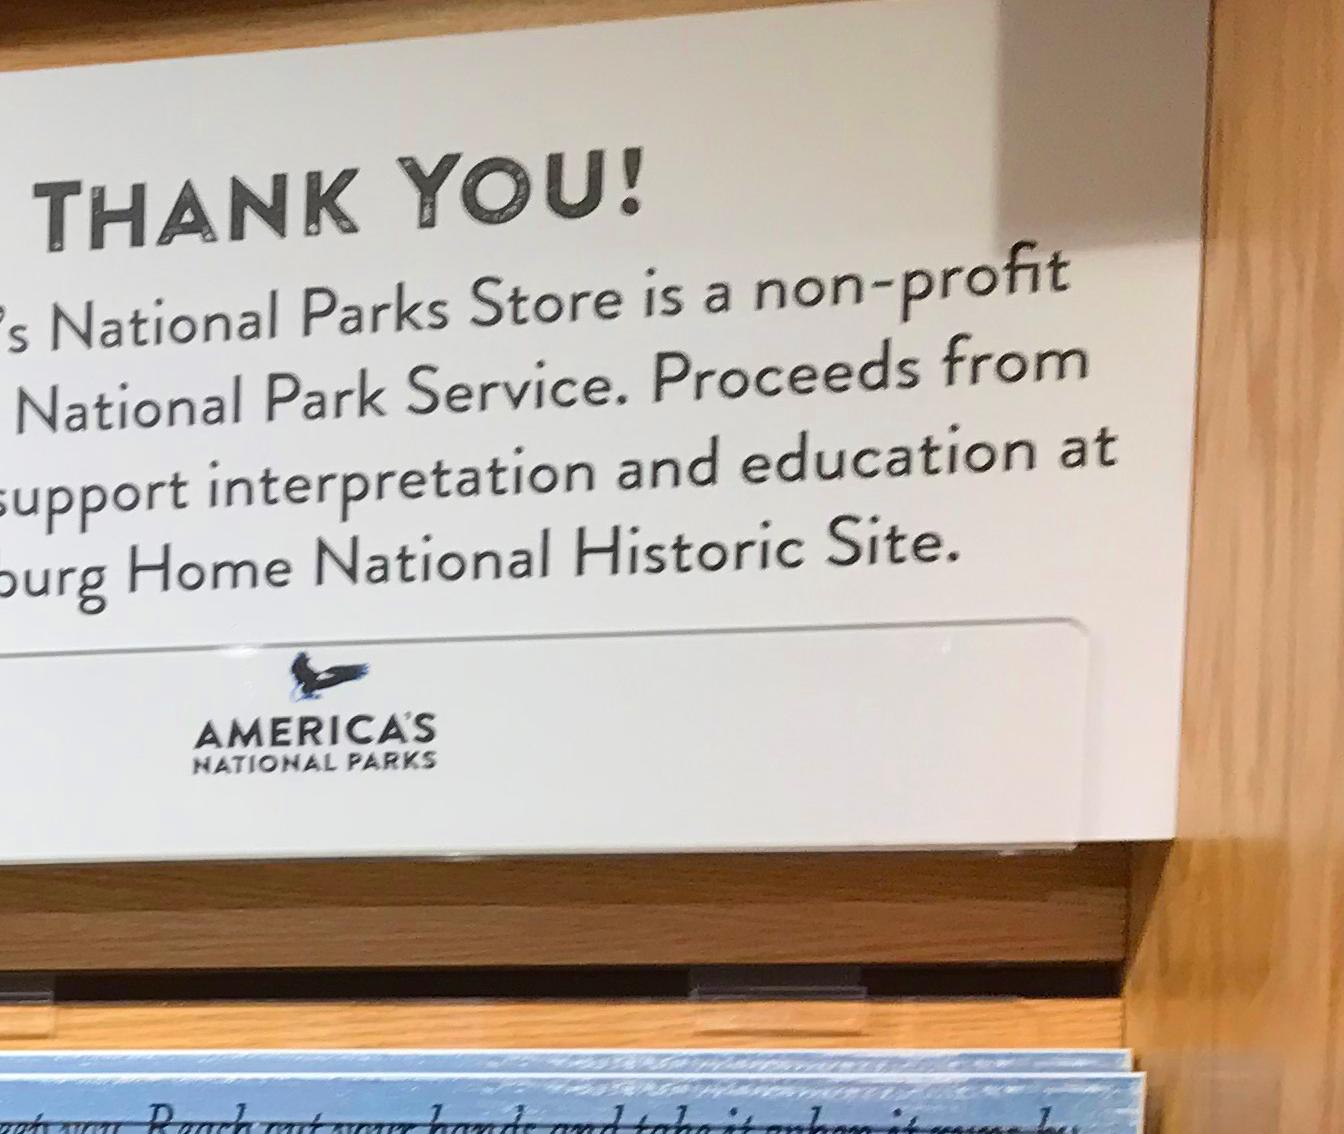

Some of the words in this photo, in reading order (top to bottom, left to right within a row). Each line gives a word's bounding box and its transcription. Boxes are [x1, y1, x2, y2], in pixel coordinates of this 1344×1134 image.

[34, 168, 358, 252] THANK
[397, 147, 642, 228] YOU!
[53, 290, 277, 350] National
[304, 282, 448, 336] Parks
[471, 276, 622, 326] Store
[646, 268, 682, 317] is
[705, 283, 730, 313] a
[757, 239, 1070, 322] non-profit
[18, 375, 241, 434] National
[267, 368, 385, 421] Park
[408, 360, 627, 414] Service.
[655, 338, 919, 402] Proceeds
[943, 333, 1087, 385] from
[211, 447, 594, 522] interpretation
[618, 435, 718, 490] and
[742, 424, 1035, 484] education
[1061, 427, 1116, 468] at
[130, 544, 291, 592] Home
[317, 528, 549, 585] National
[577, 521, 803, 576] Historic
[827, 515, 959, 566] Site.
[194, 754, 336, 774] NATIONAL
[348, 751, 436, 770] PARKS
